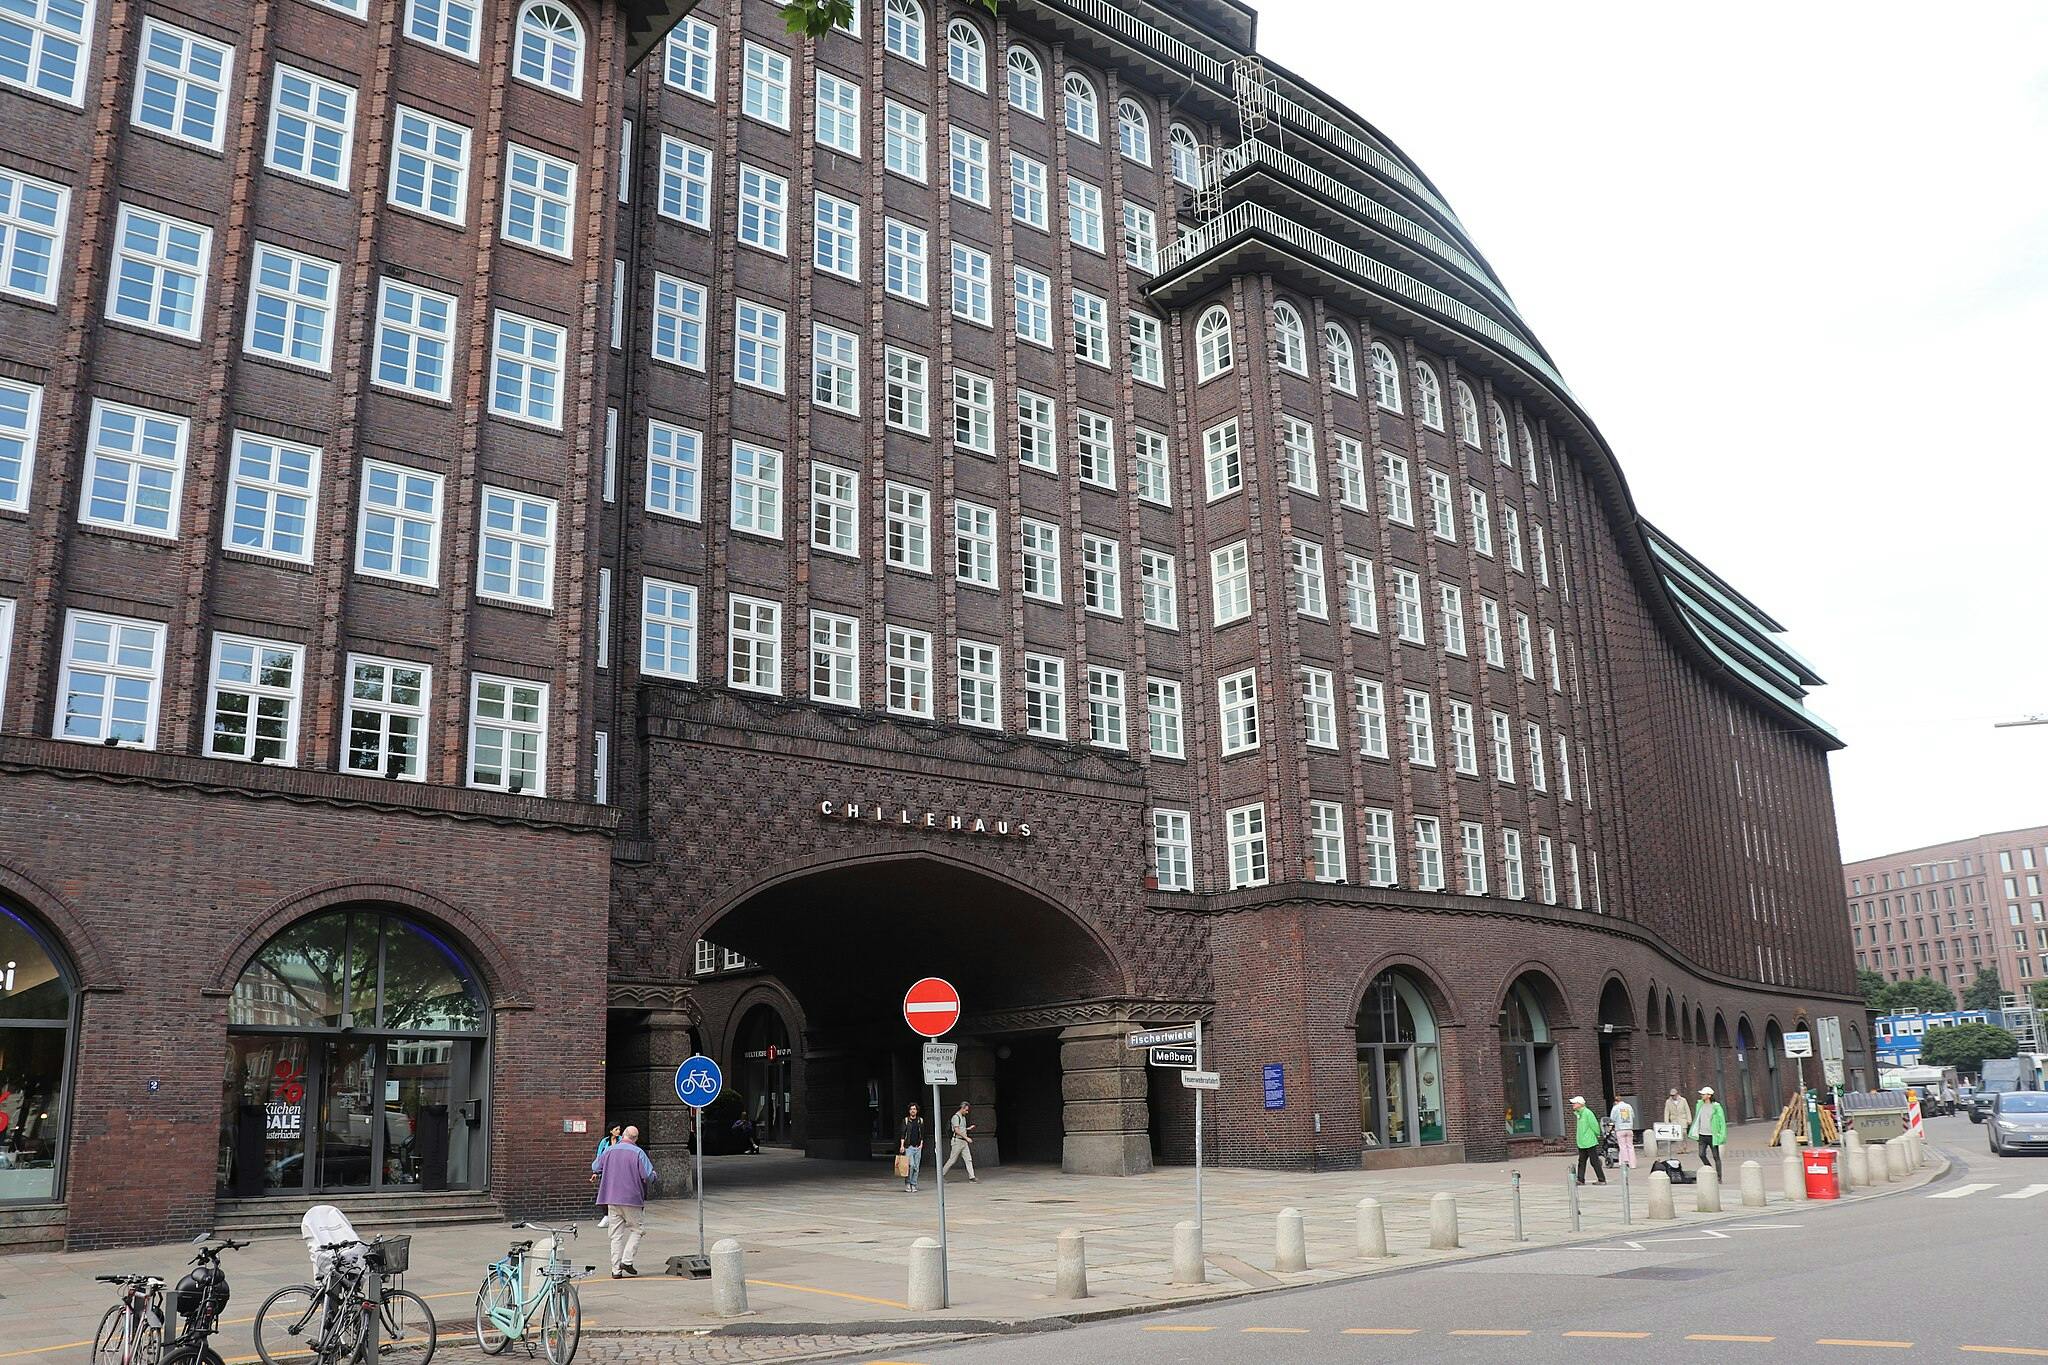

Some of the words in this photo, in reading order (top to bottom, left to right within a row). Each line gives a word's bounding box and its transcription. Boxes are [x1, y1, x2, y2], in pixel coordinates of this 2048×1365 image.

[821, 800, 1031, 837] CHILEHAUS
[1131, 1030, 1193, 1045] Fischertwiete
[926, 1046, 954, 1054] Ladezone
[1156, 1051, 1193, 1064] Meßberg
[150, 1081, 158, 1090] 2
